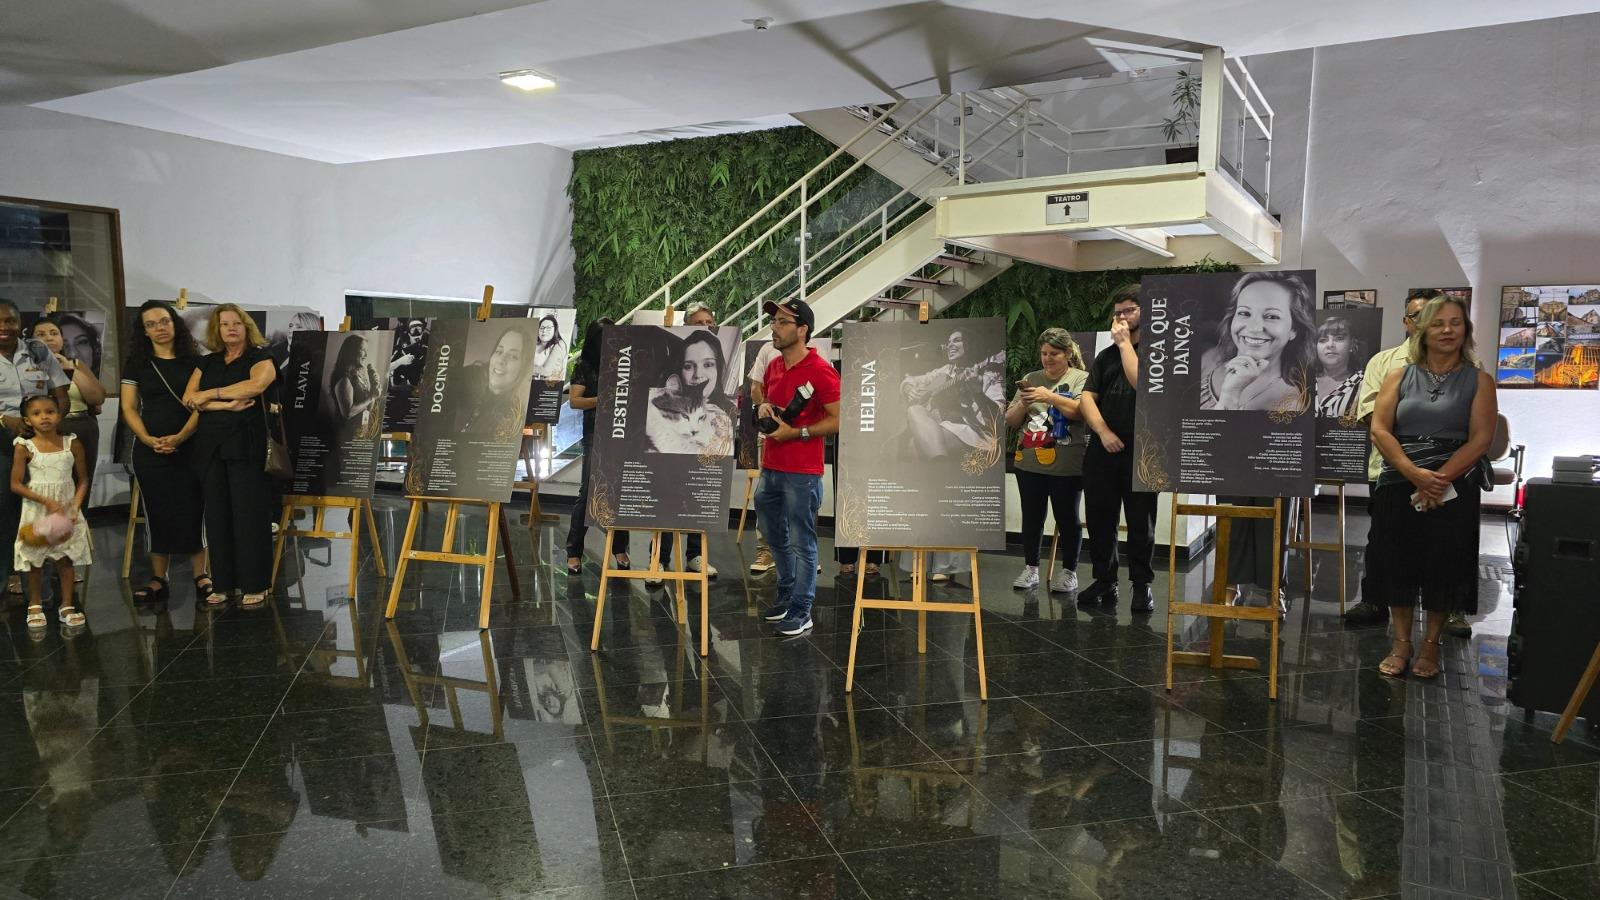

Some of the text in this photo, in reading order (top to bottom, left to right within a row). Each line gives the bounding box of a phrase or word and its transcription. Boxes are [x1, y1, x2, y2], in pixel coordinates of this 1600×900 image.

[1054, 194, 1081, 203] TEATRO
[430, 344, 451, 414] DOCINHO
[1148, 298, 1170, 394] MOÇA QUE
[1173, 314, 1194, 375] DANÇA
[294, 360, 311, 409] FLAVIA
[611, 345, 633, 439] DESTEMIDA
[859, 359, 876, 432] HELENA
